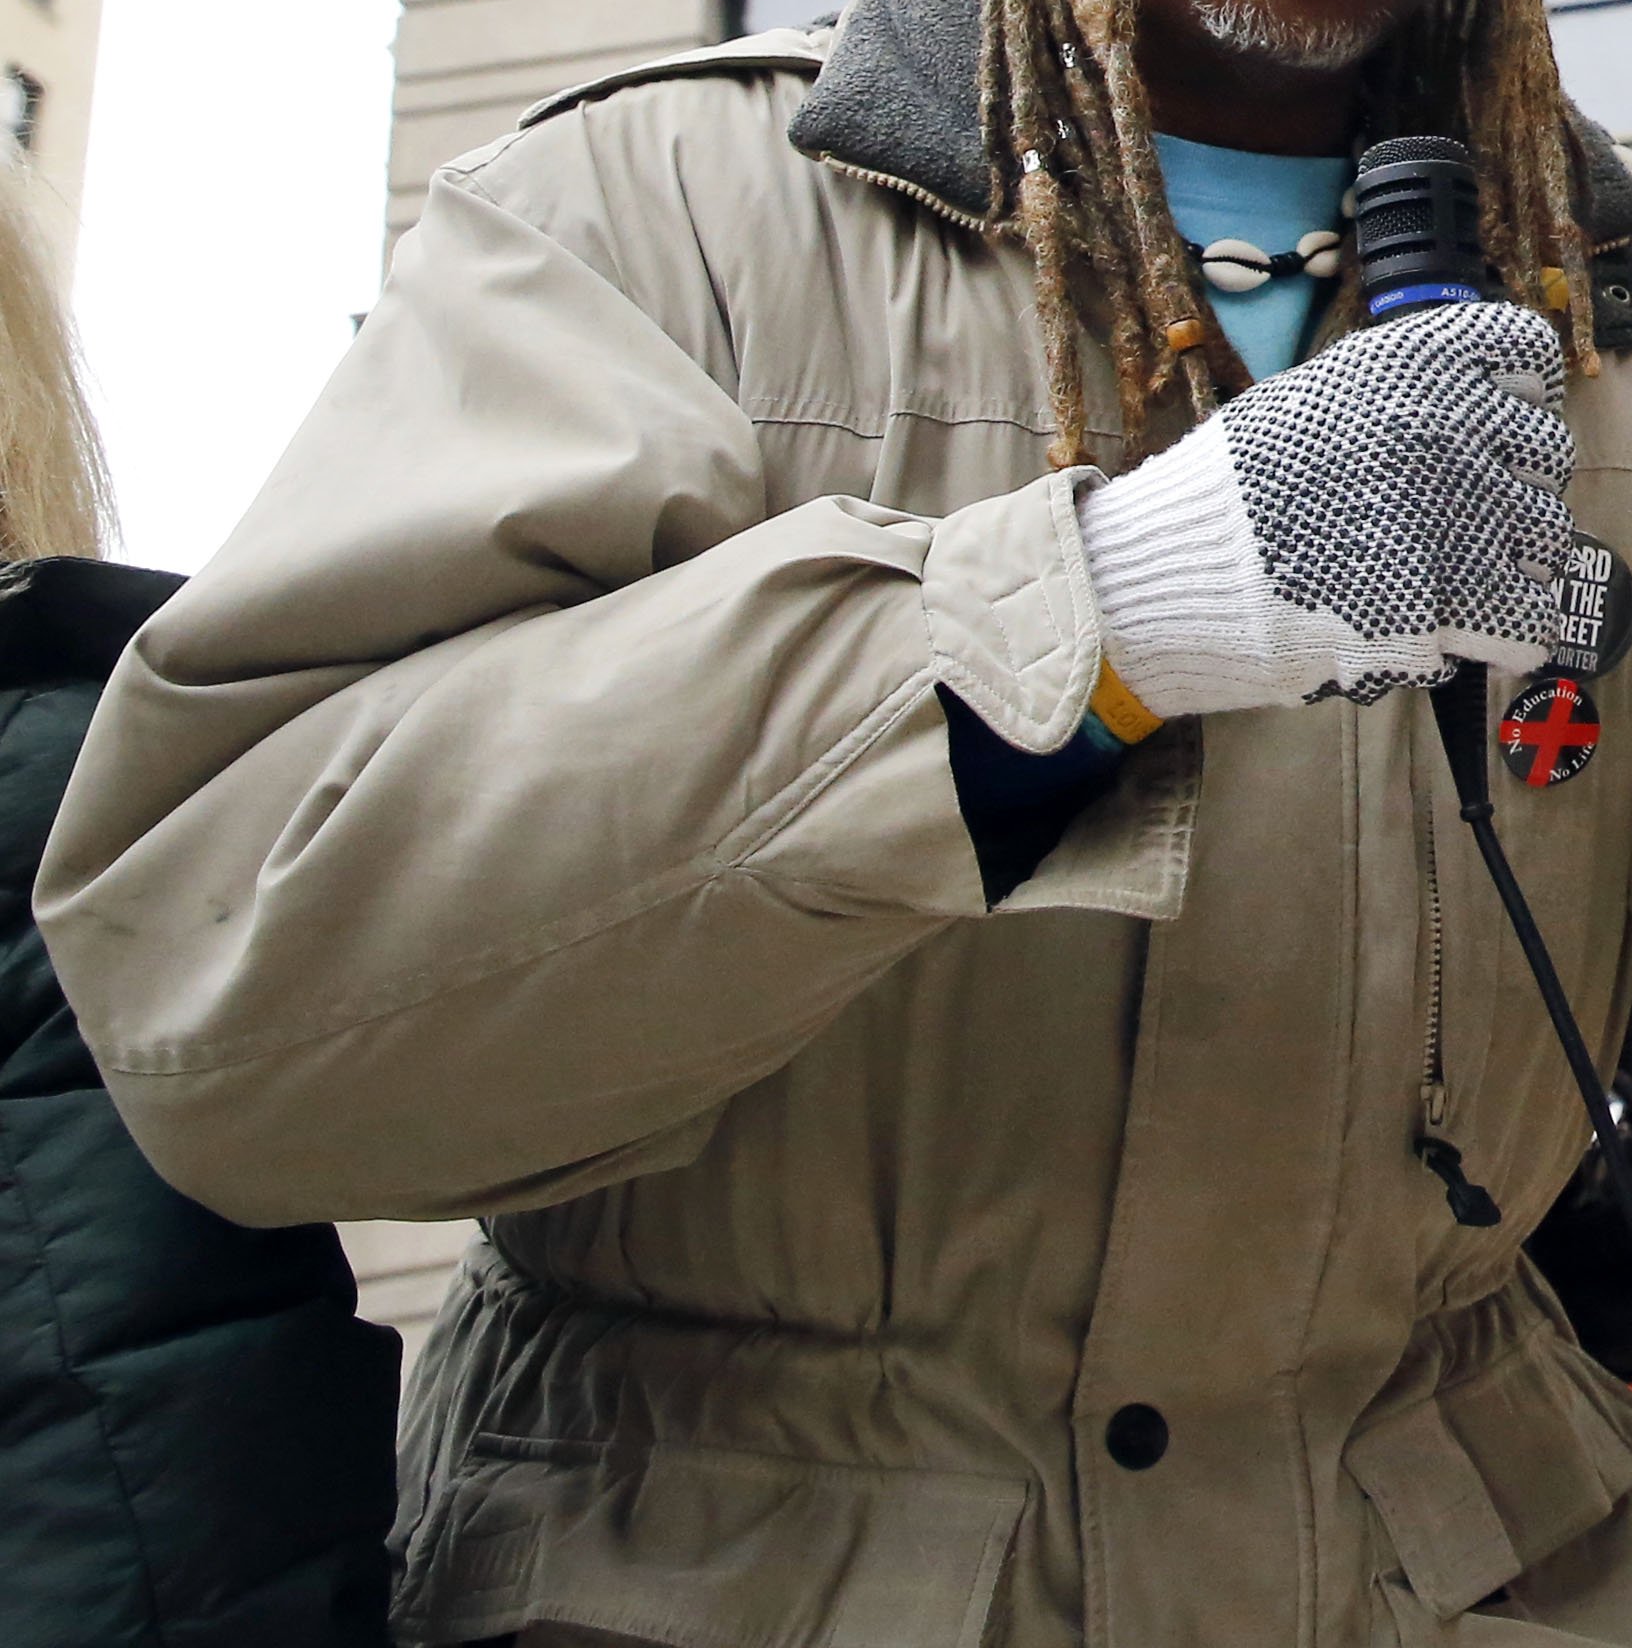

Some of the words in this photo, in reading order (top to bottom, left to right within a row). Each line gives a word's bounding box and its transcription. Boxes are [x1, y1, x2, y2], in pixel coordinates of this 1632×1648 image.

[1569, 579, 1608, 618] THE
[1558, 613, 1603, 647] REET
[1550, 645, 1599, 672] PORTER
[1512, 686, 1583, 724] Education
[1507, 728, 1523, 756] No
[1549, 767, 1570, 782] No
